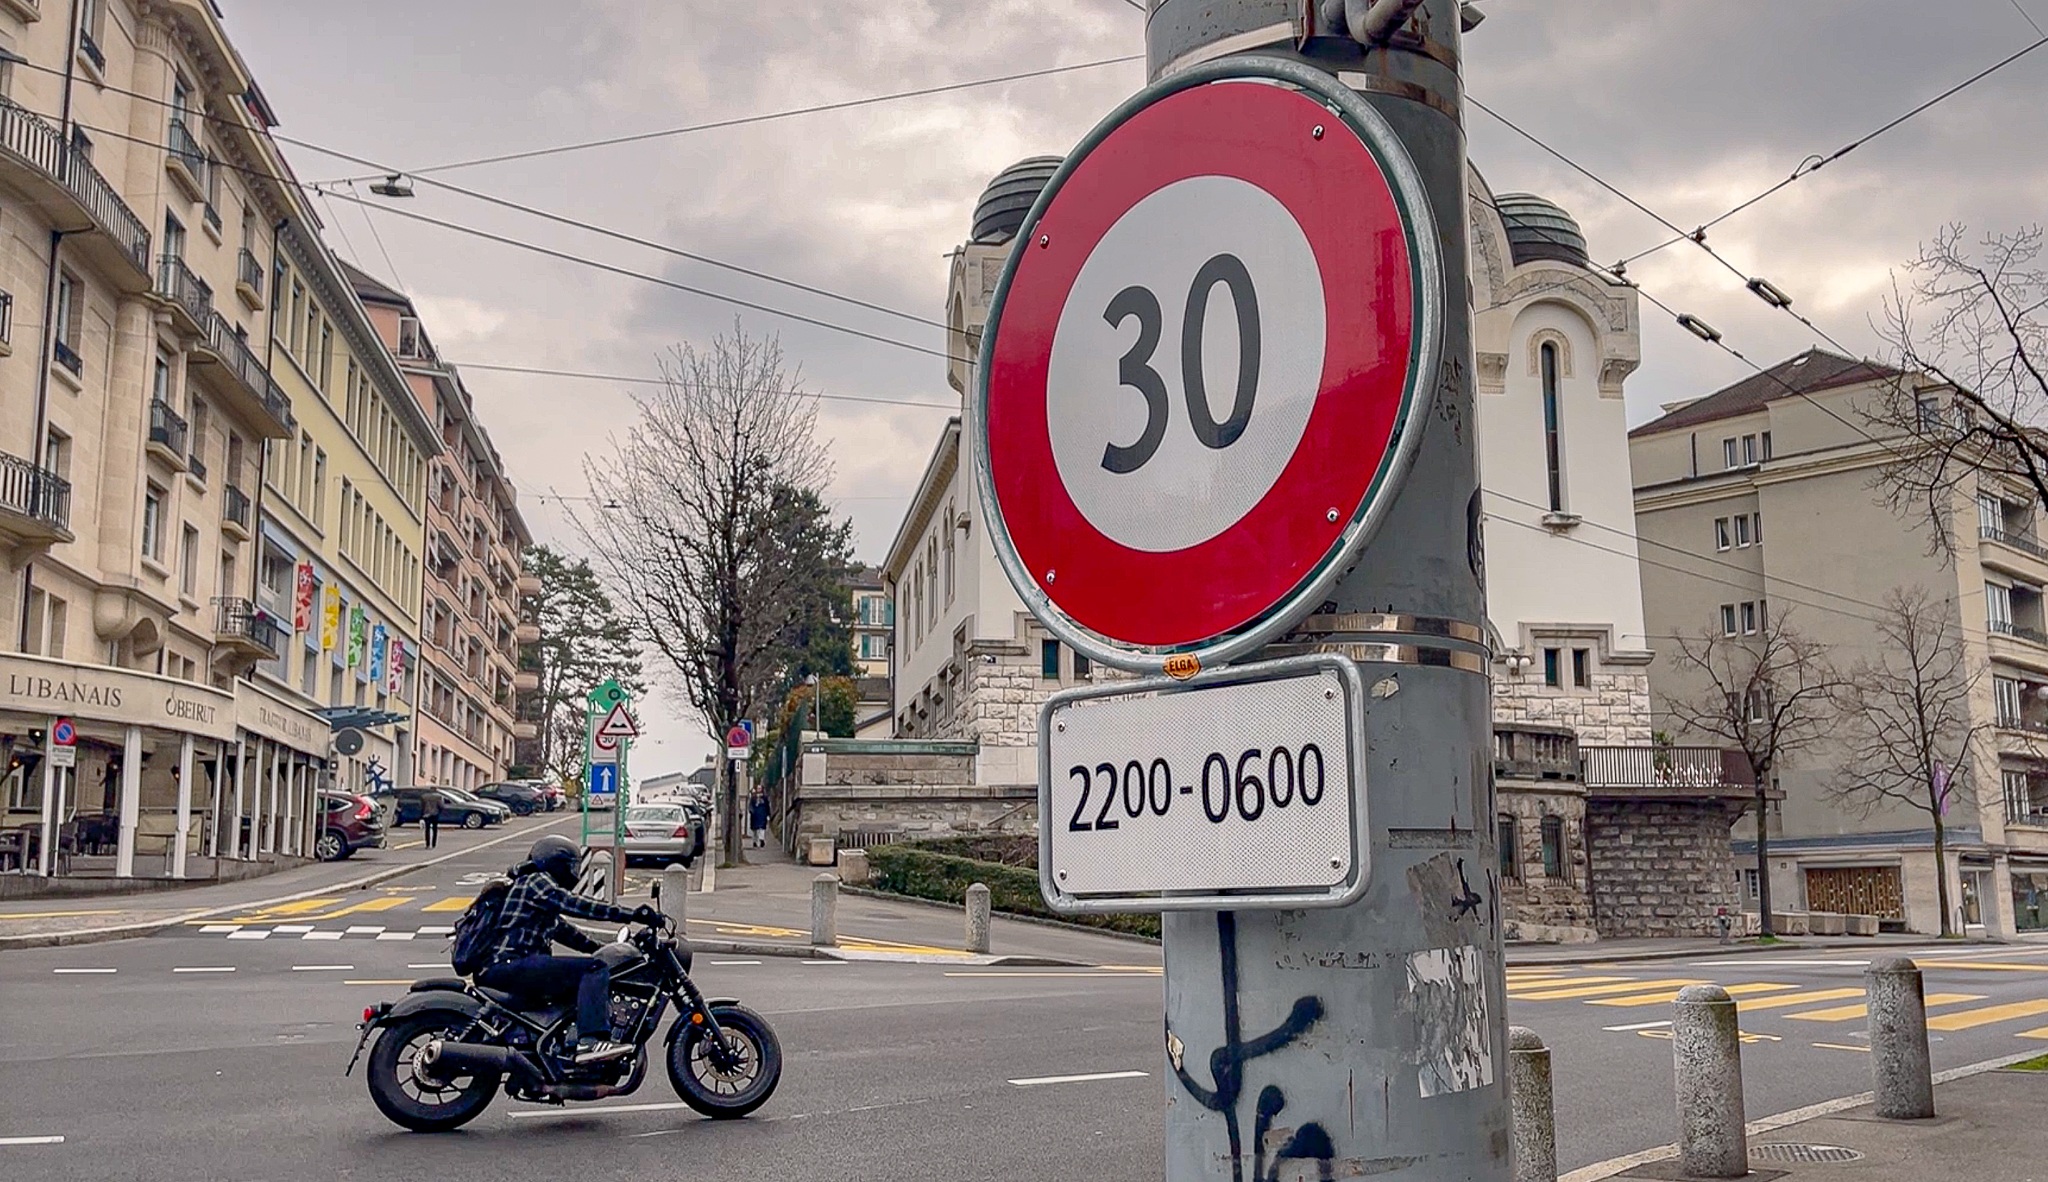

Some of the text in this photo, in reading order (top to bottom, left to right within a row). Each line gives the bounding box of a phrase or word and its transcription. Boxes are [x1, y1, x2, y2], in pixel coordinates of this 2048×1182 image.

[1101, 253, 1261, 474] 30
[9, 674, 122, 708] LIBANAIS
[1169, 659, 1195, 671] ELGA
[1069, 742, 1325, 832] 2200-0600
